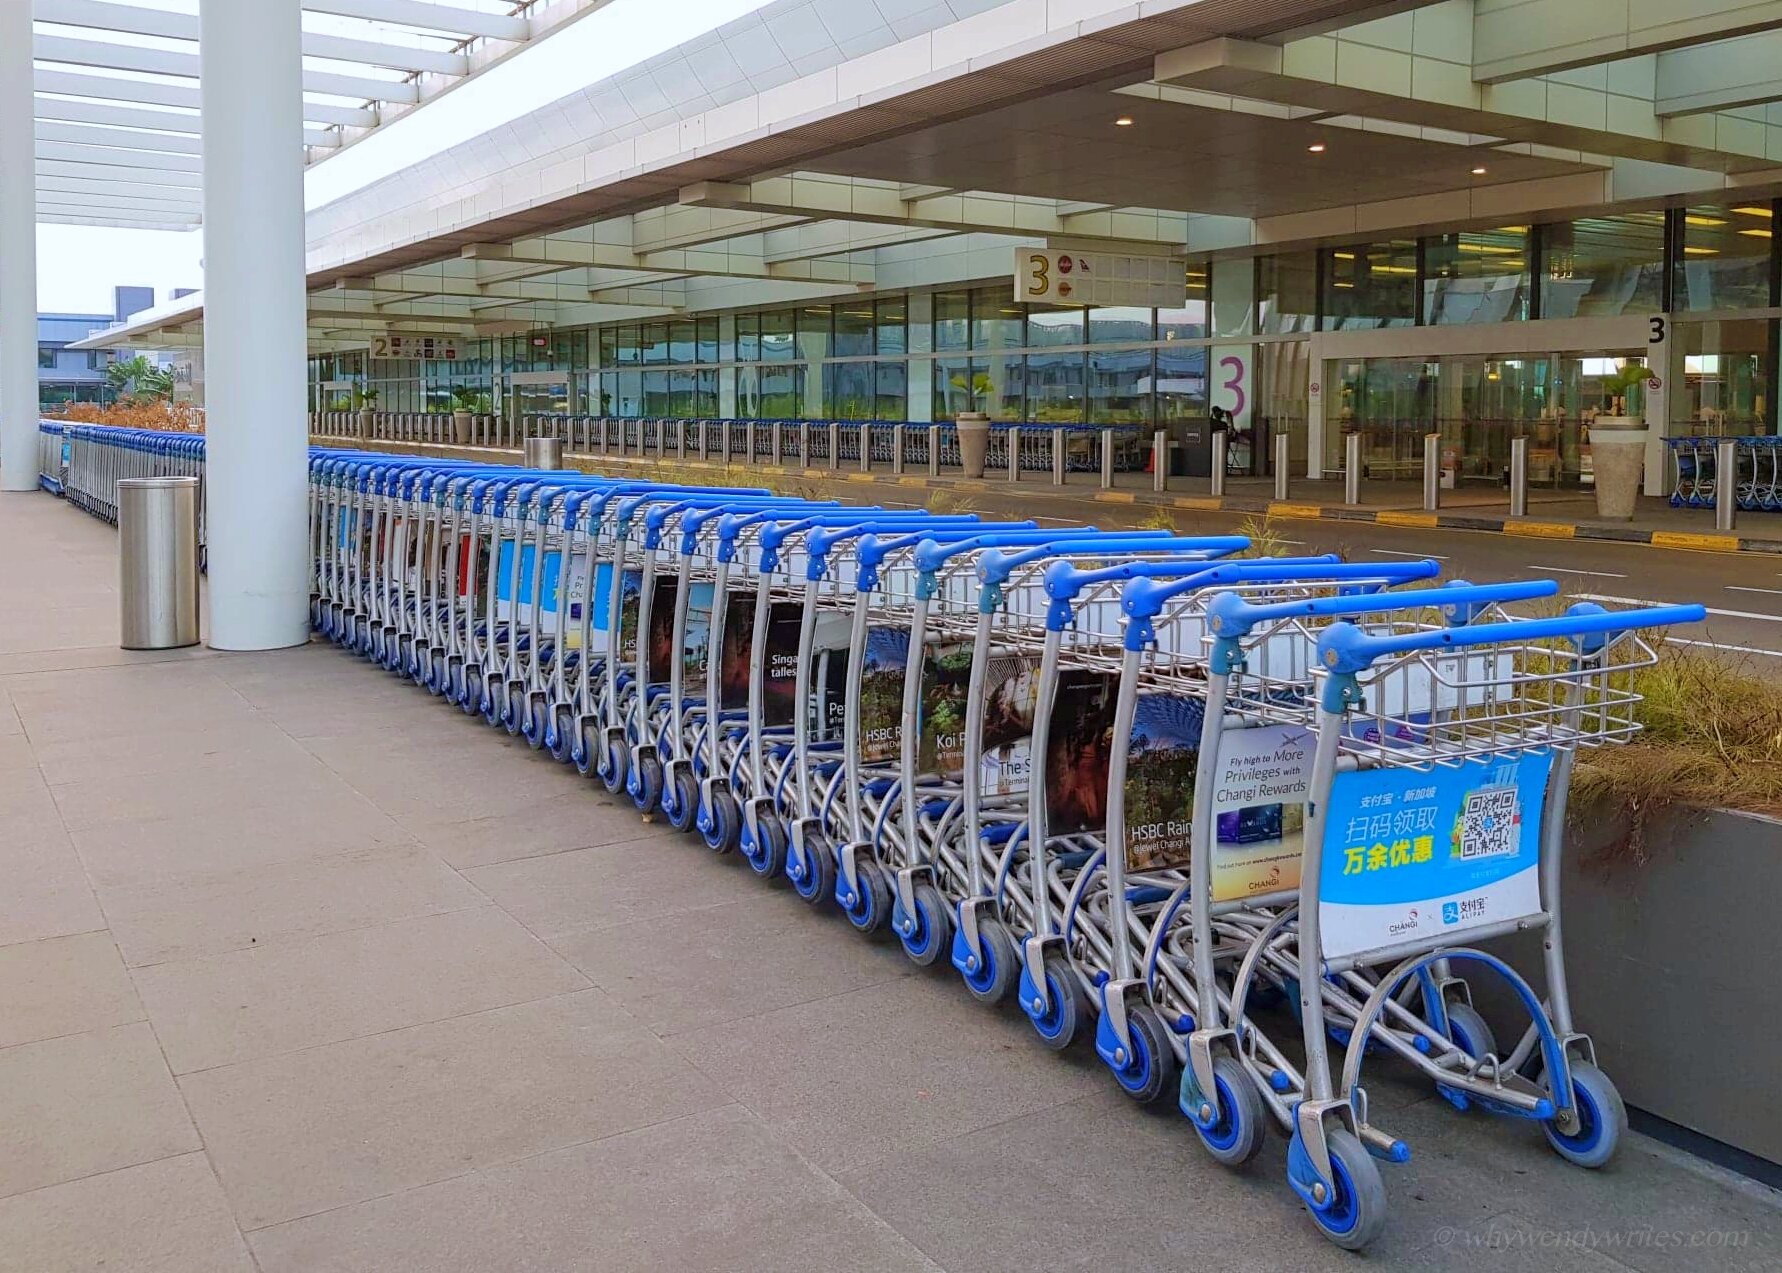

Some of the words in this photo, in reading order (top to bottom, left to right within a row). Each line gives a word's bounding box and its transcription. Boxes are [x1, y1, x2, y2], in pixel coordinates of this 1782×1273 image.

[1028, 254, 1049, 295] 3
[1649, 317, 1665, 343] 3
[375, 338, 387, 357] 2
[1219, 356, 1245, 417] 3
[624, 640, 636, 648] HS
[829, 702, 844, 715] Pe
[866, 727, 893, 742] HSBC
[936, 732, 956, 750] Koi
[1230, 757, 1242, 767] Fly
[1243, 755, 1260, 766] high
[1262, 754, 1270, 762] to
[1273, 749, 1304, 762] More
[999, 761, 1021, 776] The
[1225, 766, 1281, 783] Privileges
[1283, 766, 1301, 776] with
[1217, 784, 1256, 803] Changi
[1259, 779, 1306, 797] Rewards
[1131, 823, 1164, 842] HSBC
[1345, 806, 1438, 844] 扫码领取
[1343, 834, 1434, 876] 万余优惠
[1248, 878, 1280, 890] CHANGI
[1461, 910, 1485, 920] ALIPAY
[1389, 921, 1418, 933] CHANGI
